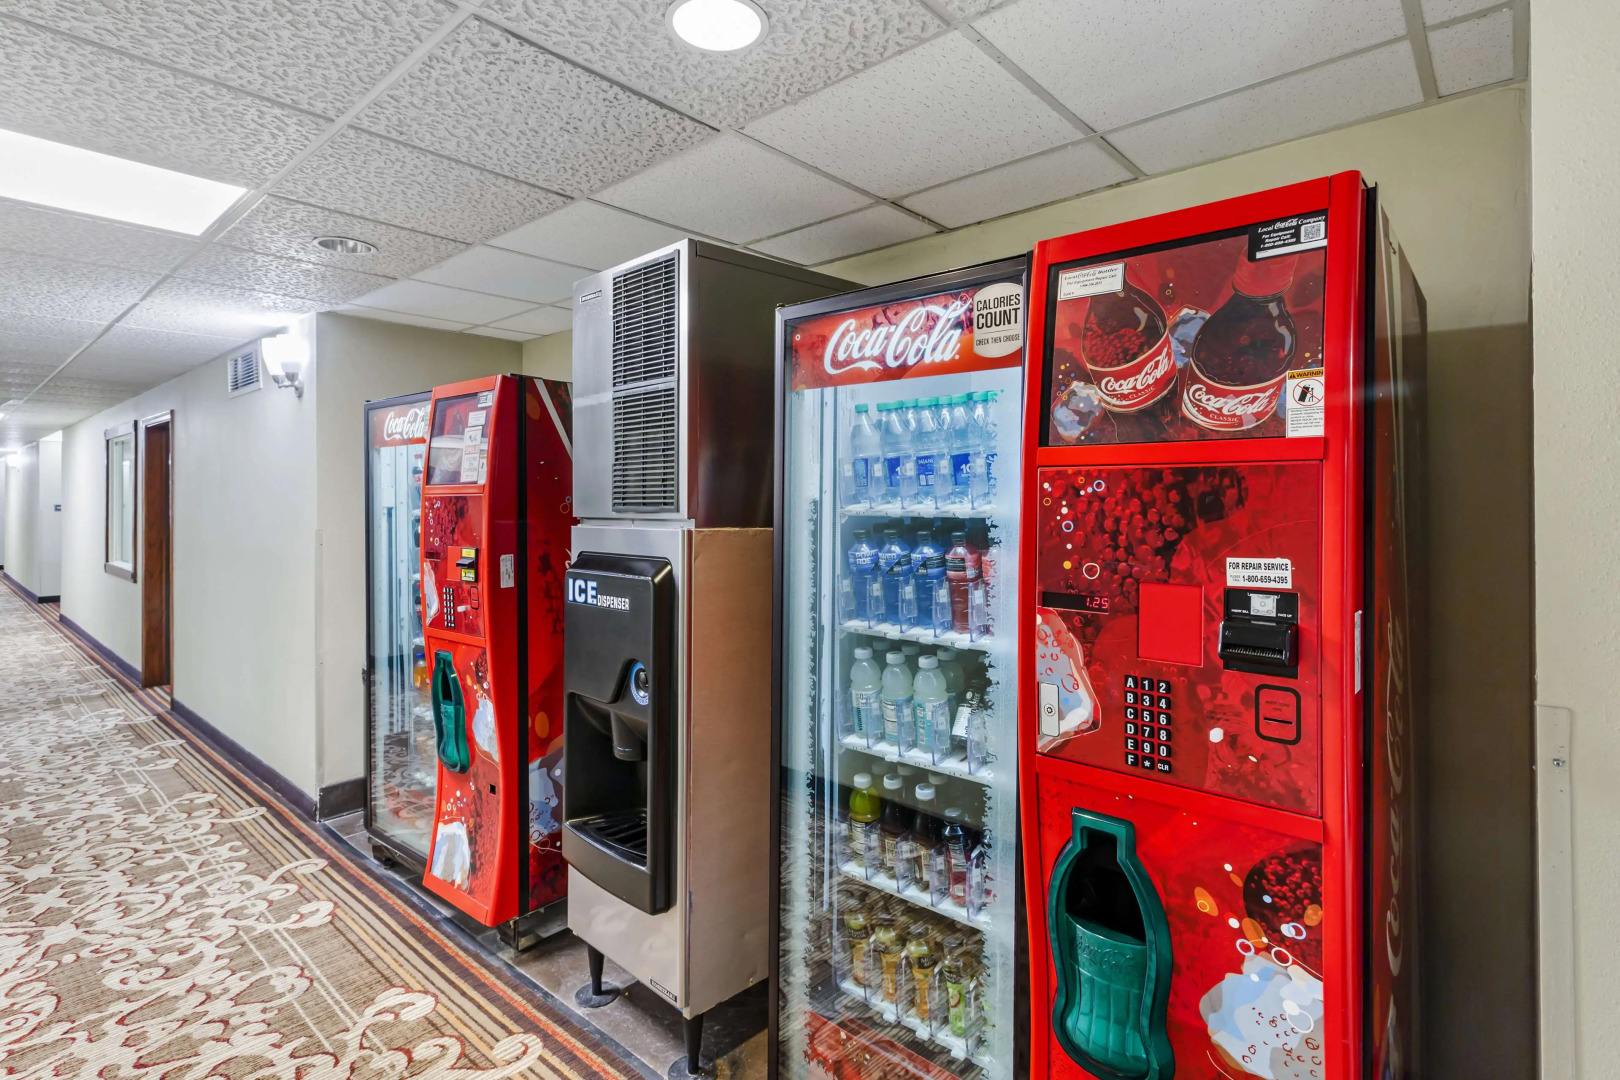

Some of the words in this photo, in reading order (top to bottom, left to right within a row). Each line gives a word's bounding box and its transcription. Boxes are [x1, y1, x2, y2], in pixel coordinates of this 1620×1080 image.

[976, 293, 1021, 312] CALORIES
[976, 307, 1021, 330] COUNT
[824, 298, 972, 375] Coca-Cola
[976, 338, 989, 346] CHECK
[991, 336, 1002, 344] THEN
[1003, 333, 1020, 342] CHOOSE
[1101, 343, 1169, 394] Coca-Cola
[1296, 369, 1323, 378] WARNIN
[1129, 385, 1156, 399] CLASSIC
[1189, 384, 1277, 415] Coca-Cola
[383, 407, 425, 441] Coca-Cola
[1209, 413, 1238, 422] CLASSIC
[1228, 562, 1240, 570] FOR
[1241, 562, 1263, 571] REPAIR
[1263, 563, 1289, 571] SERVICE
[1242, 574, 1289, 584] 1-800-659-4395
[568, 577, 597, 605] ICE
[597, 594, 630, 610] DISPENSER
[1086, 597, 1109, 609] 1.25
[1126, 677, 1135, 688] A
[1143, 680, 1149, 691] 1
[1159, 682, 1167, 693] 2
[1126, 692, 1134, 703] B
[1143, 695, 1150, 706] 3
[1159, 698, 1167, 709] 4
[1126, 708, 1134, 719] C
[1143, 711, 1150, 722] 5
[1159, 714, 1167, 725] 6
[1126, 723, 1135, 734] D
[1143, 726, 1150, 737] 7
[1159, 730, 1167, 741] 8
[1127, 739, 1134, 750] E
[1143, 742, 1150, 753] 9
[1159, 745, 1167, 757] 0
[1127, 754, 1134, 765] F
[1157, 763, 1169, 771] CLR
